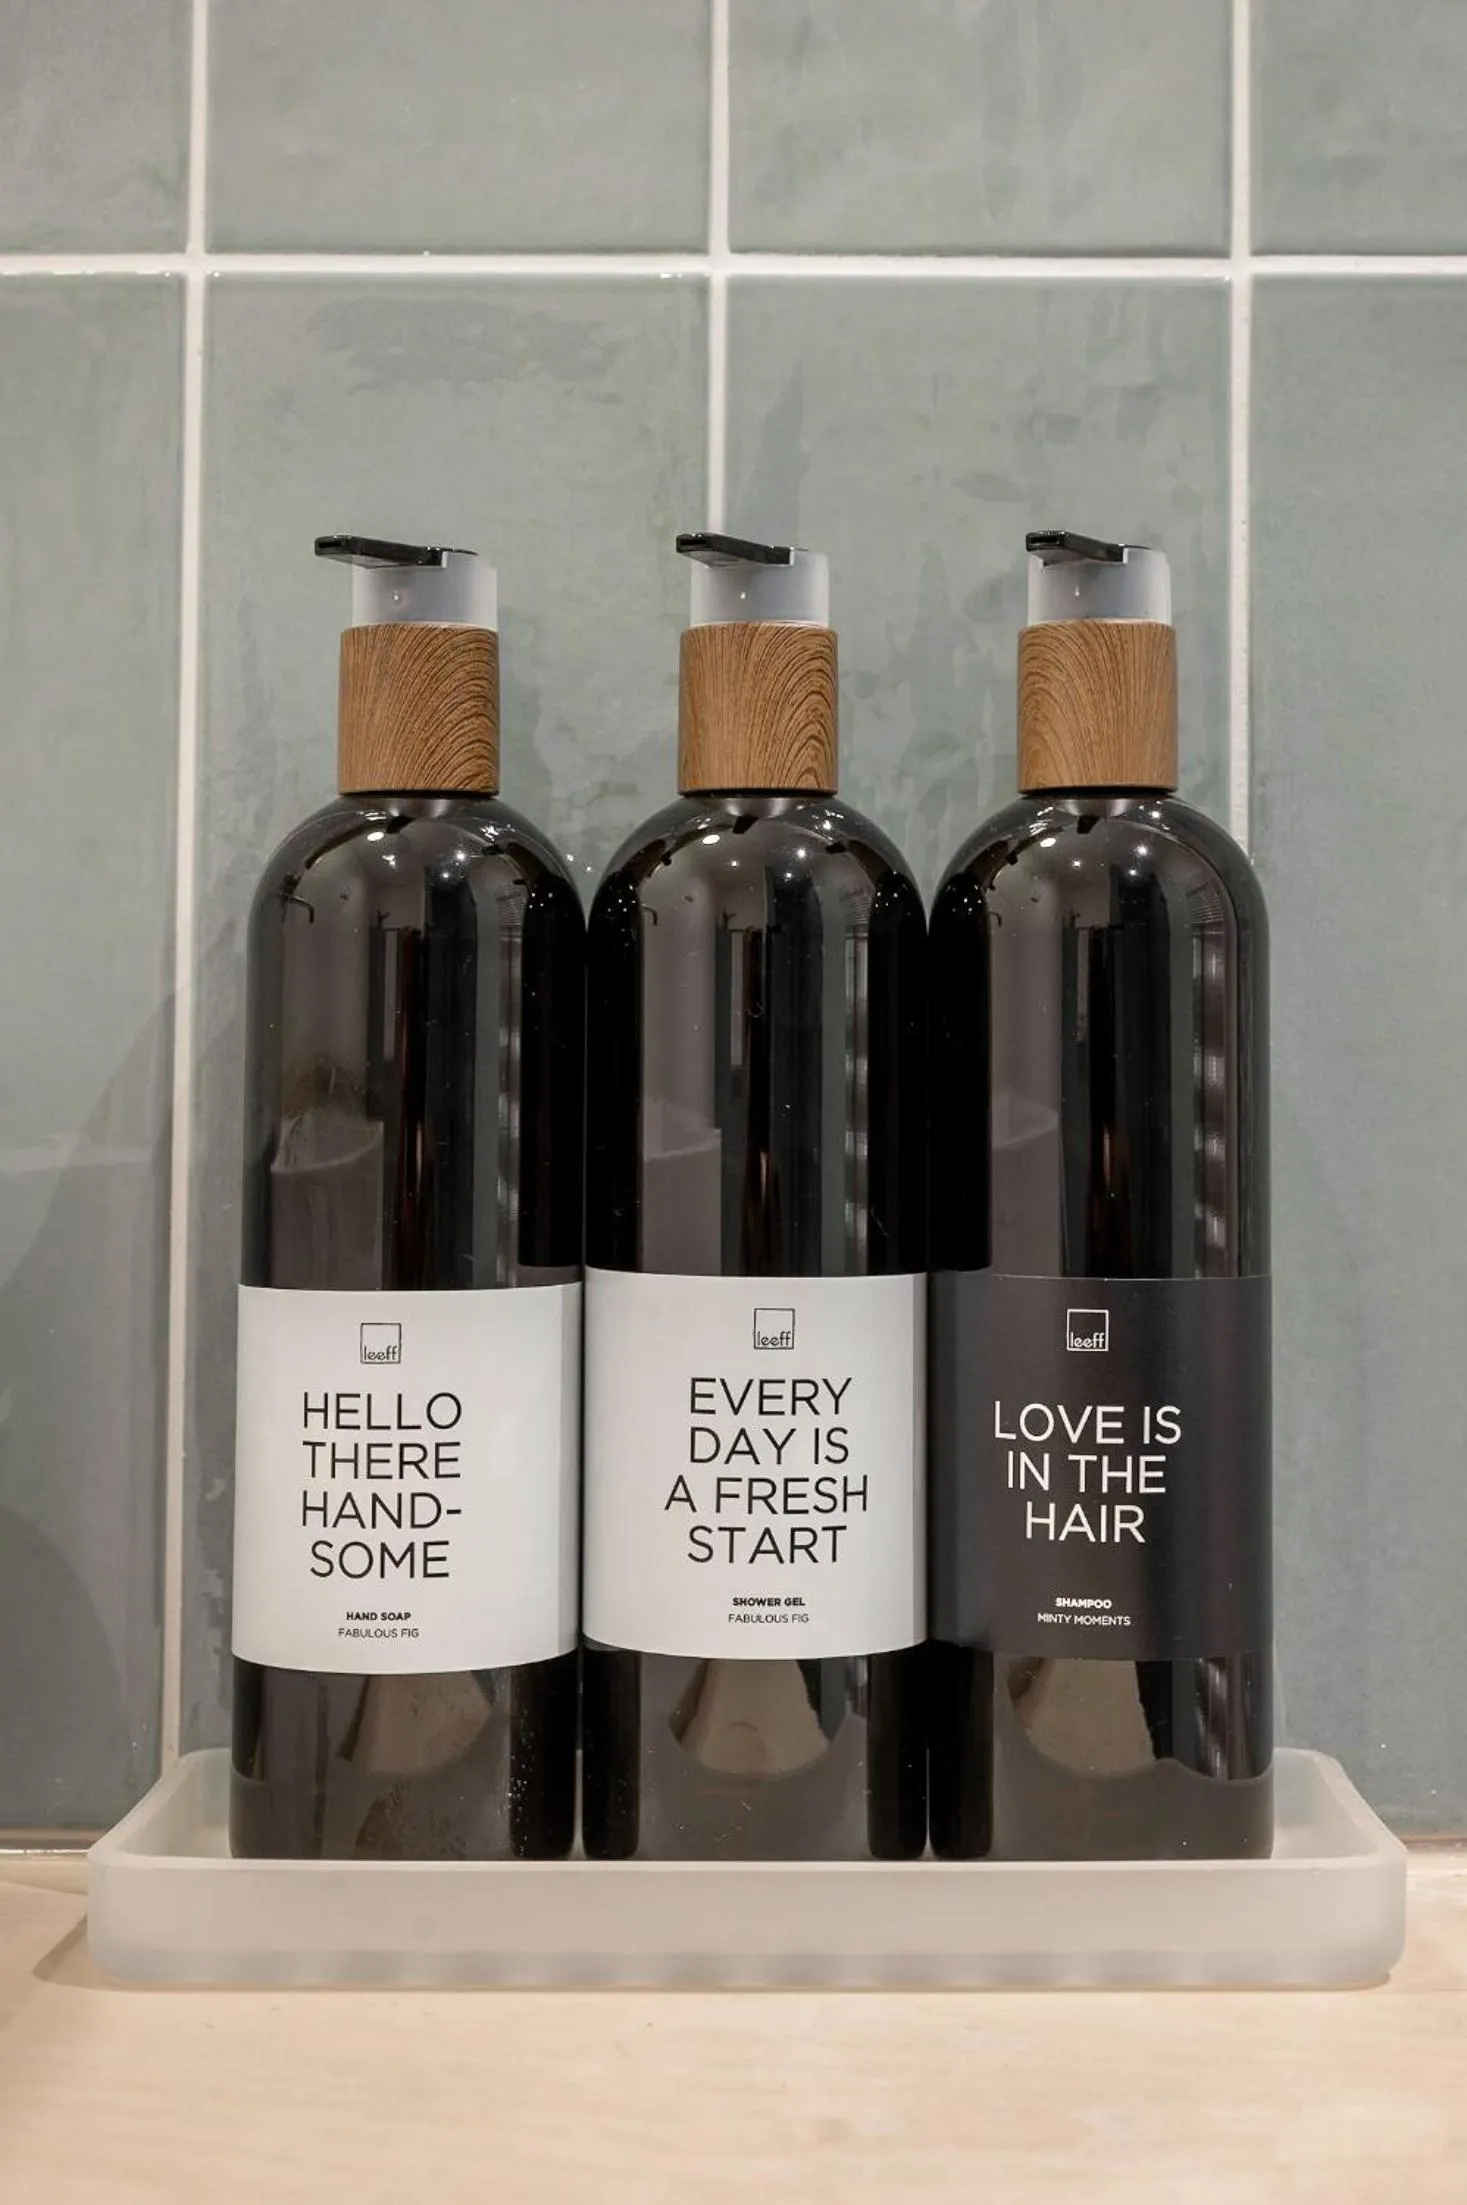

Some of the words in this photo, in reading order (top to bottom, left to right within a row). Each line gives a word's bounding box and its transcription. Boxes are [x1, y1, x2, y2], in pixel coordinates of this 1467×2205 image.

[364, 1345, 397, 1361] leeff
[757, 1330, 791, 1347] leeff
[1070, 1332, 1105, 1348] leeff
[304, 1392, 462, 1430] HELLO
[690, 1377, 852, 1416] EVERY
[994, 1400, 1124, 1444] LOVE
[1143, 1405, 1181, 1445] IS
[302, 1440, 461, 1479] THERE
[690, 1426, 797, 1465] DAY
[813, 1427, 848, 1465] IS
[1007, 1450, 1050, 1491] IN
[1068, 1454, 1166, 1493] THE
[301, 1490, 462, 1529] HAND-
[664, 1475, 697, 1513] A
[715, 1475, 868, 1515] FRESH
[1026, 1501, 1146, 1543] HAIR
[310, 1540, 450, 1579] SOME
[687, 1525, 847, 1564] START
[346, 1612, 377, 1621] HAND
[381, 1612, 411, 1621] SOAP
[728, 1613, 788, 1623] FABULOUS
[791, 1613, 809, 1623] FIG
[732, 1597, 781, 1607] SHOWER
[784, 1597, 805, 1607] GEL
[1038, 1613, 1071, 1624] MINTY
[1074, 1614, 1130, 1626] MOMENTS
[1055, 1598, 1111, 1609] SHAMPOO
[338, 1628, 398, 1638] FABULOUS
[401, 1629, 419, 1638] FIG
